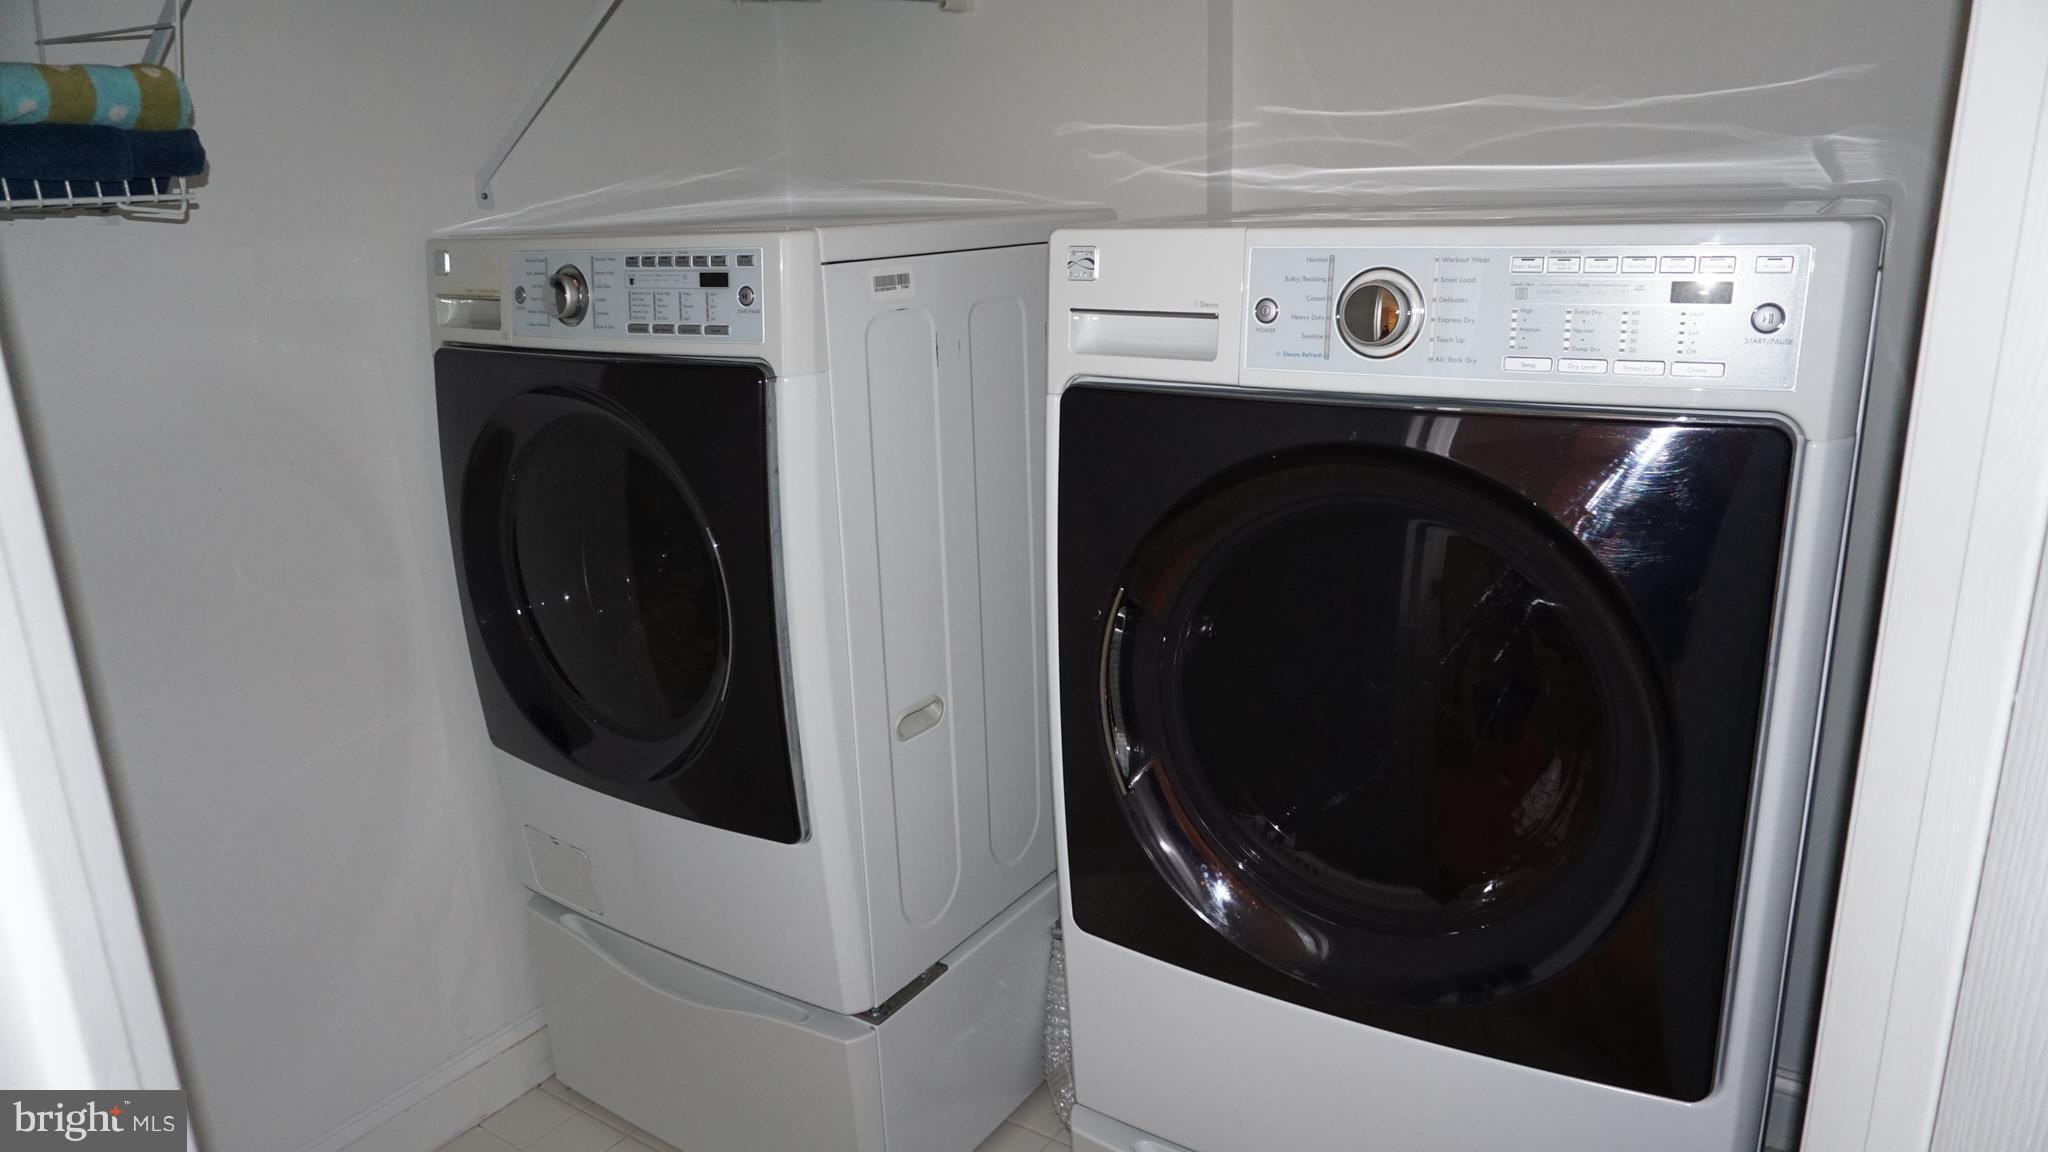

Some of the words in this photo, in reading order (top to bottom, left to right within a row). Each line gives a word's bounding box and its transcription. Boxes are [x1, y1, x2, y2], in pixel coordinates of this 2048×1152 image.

[1291, 314, 1310, 322] Heavy
[1437, 316, 1461, 324] Express
[1463, 316, 1475, 324] Dry
[1436, 335, 1454, 343] Touch
[1282, 350, 1301, 358] Steam
[1567, 362, 1579, 370] Dry
